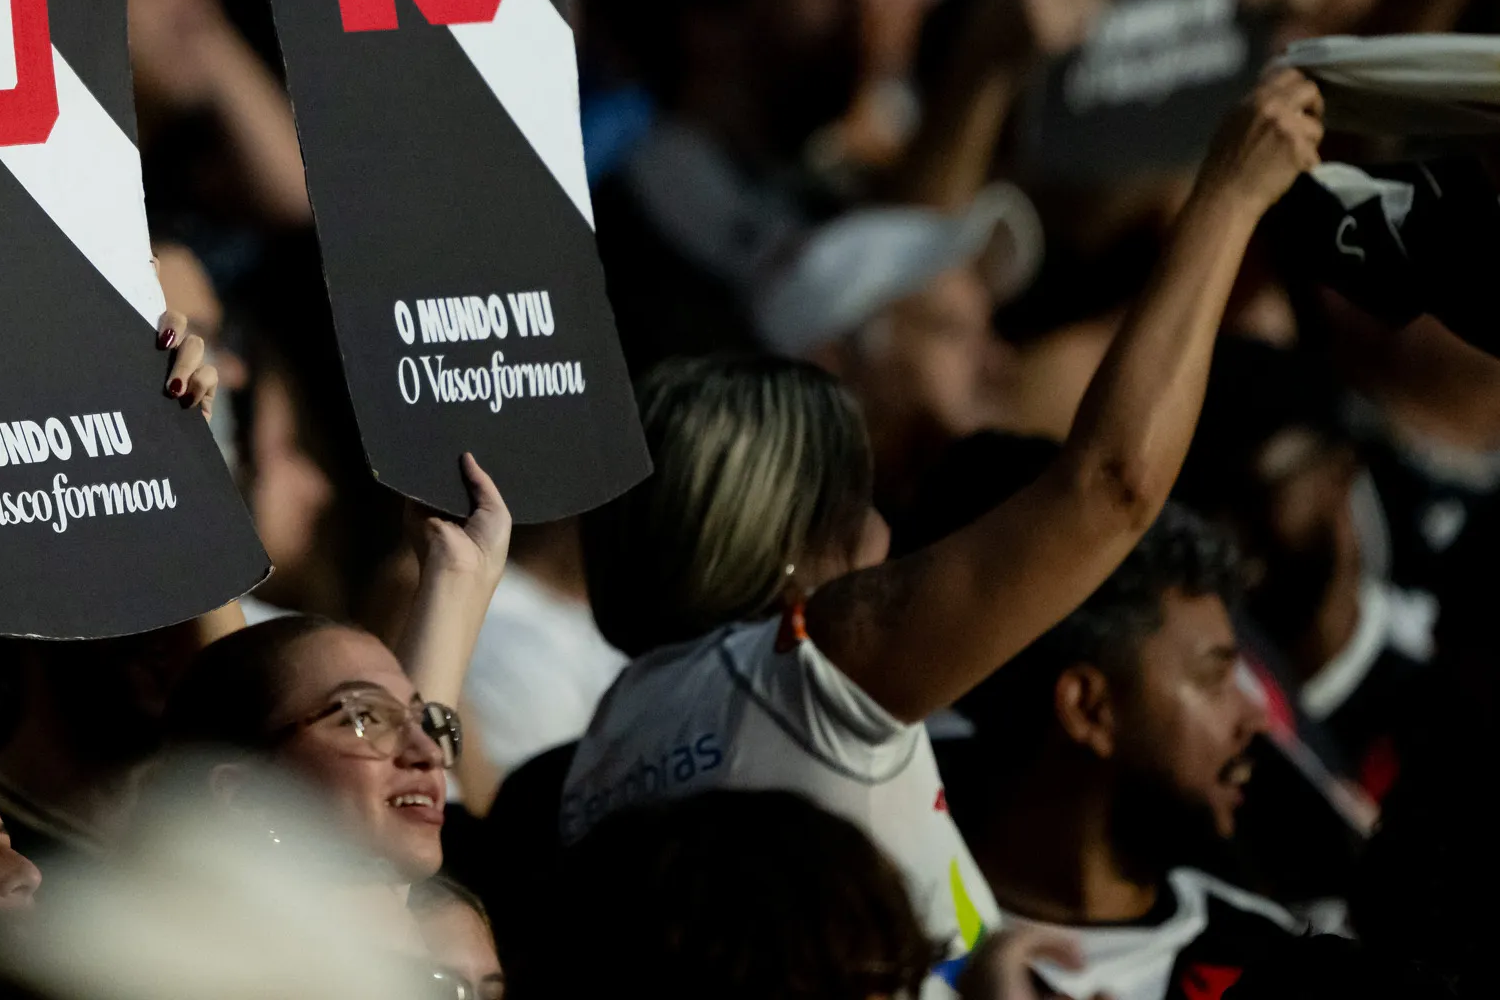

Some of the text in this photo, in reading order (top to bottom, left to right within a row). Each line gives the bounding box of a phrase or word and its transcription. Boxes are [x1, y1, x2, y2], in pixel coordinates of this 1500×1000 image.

[394, 290, 555, 345] O MUNDO VIU
[398, 356, 421, 404] O
[70, 411, 133, 458] VIU
